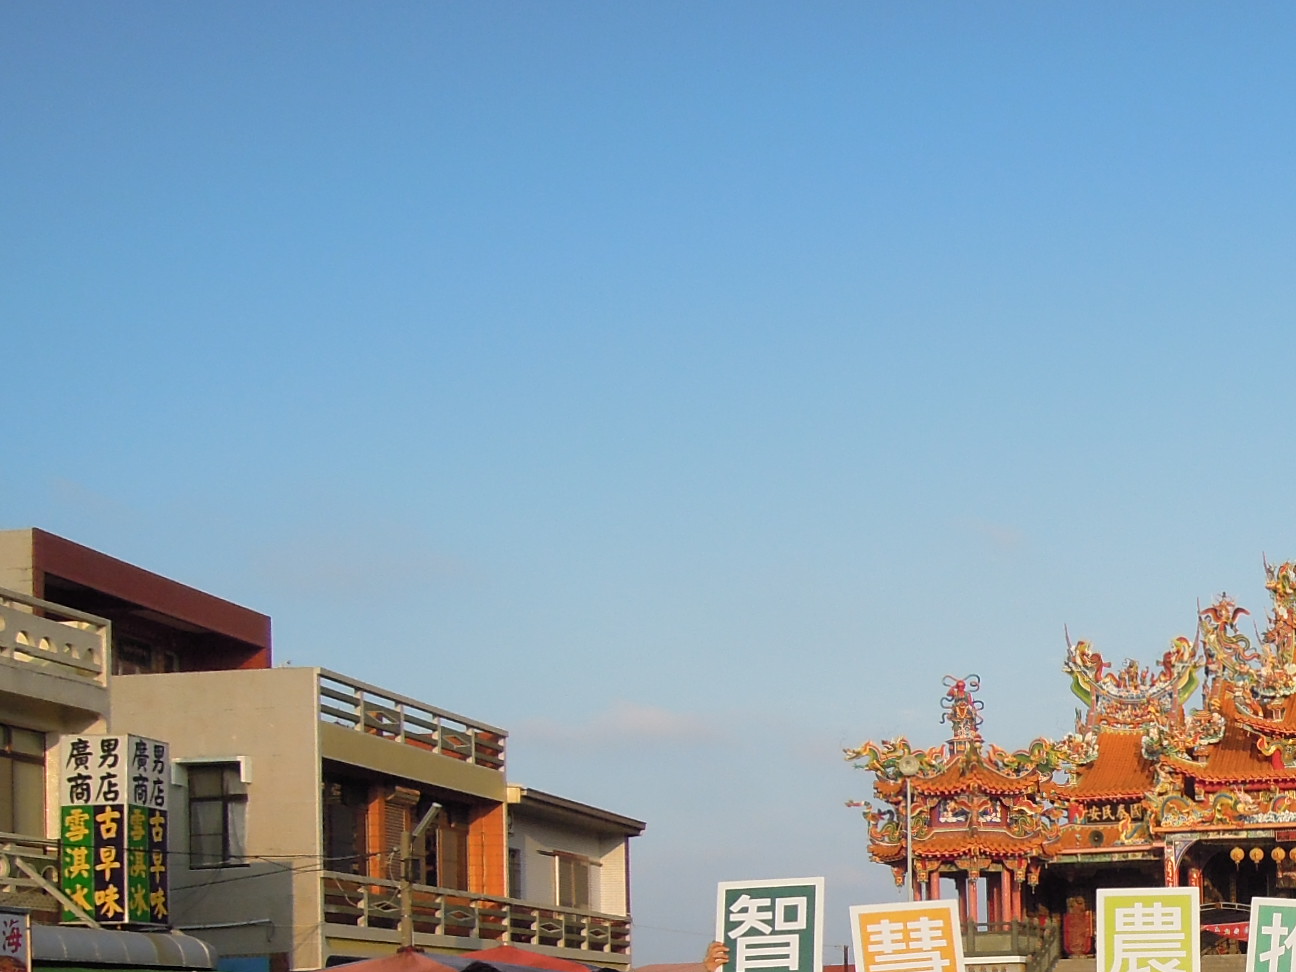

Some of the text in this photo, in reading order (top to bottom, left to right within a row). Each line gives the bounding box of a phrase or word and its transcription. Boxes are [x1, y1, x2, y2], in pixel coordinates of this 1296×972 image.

[95, 805, 123, 919] 古早味
[151, 810, 168, 919] 古早味
[3, 918, 23, 954] 海
